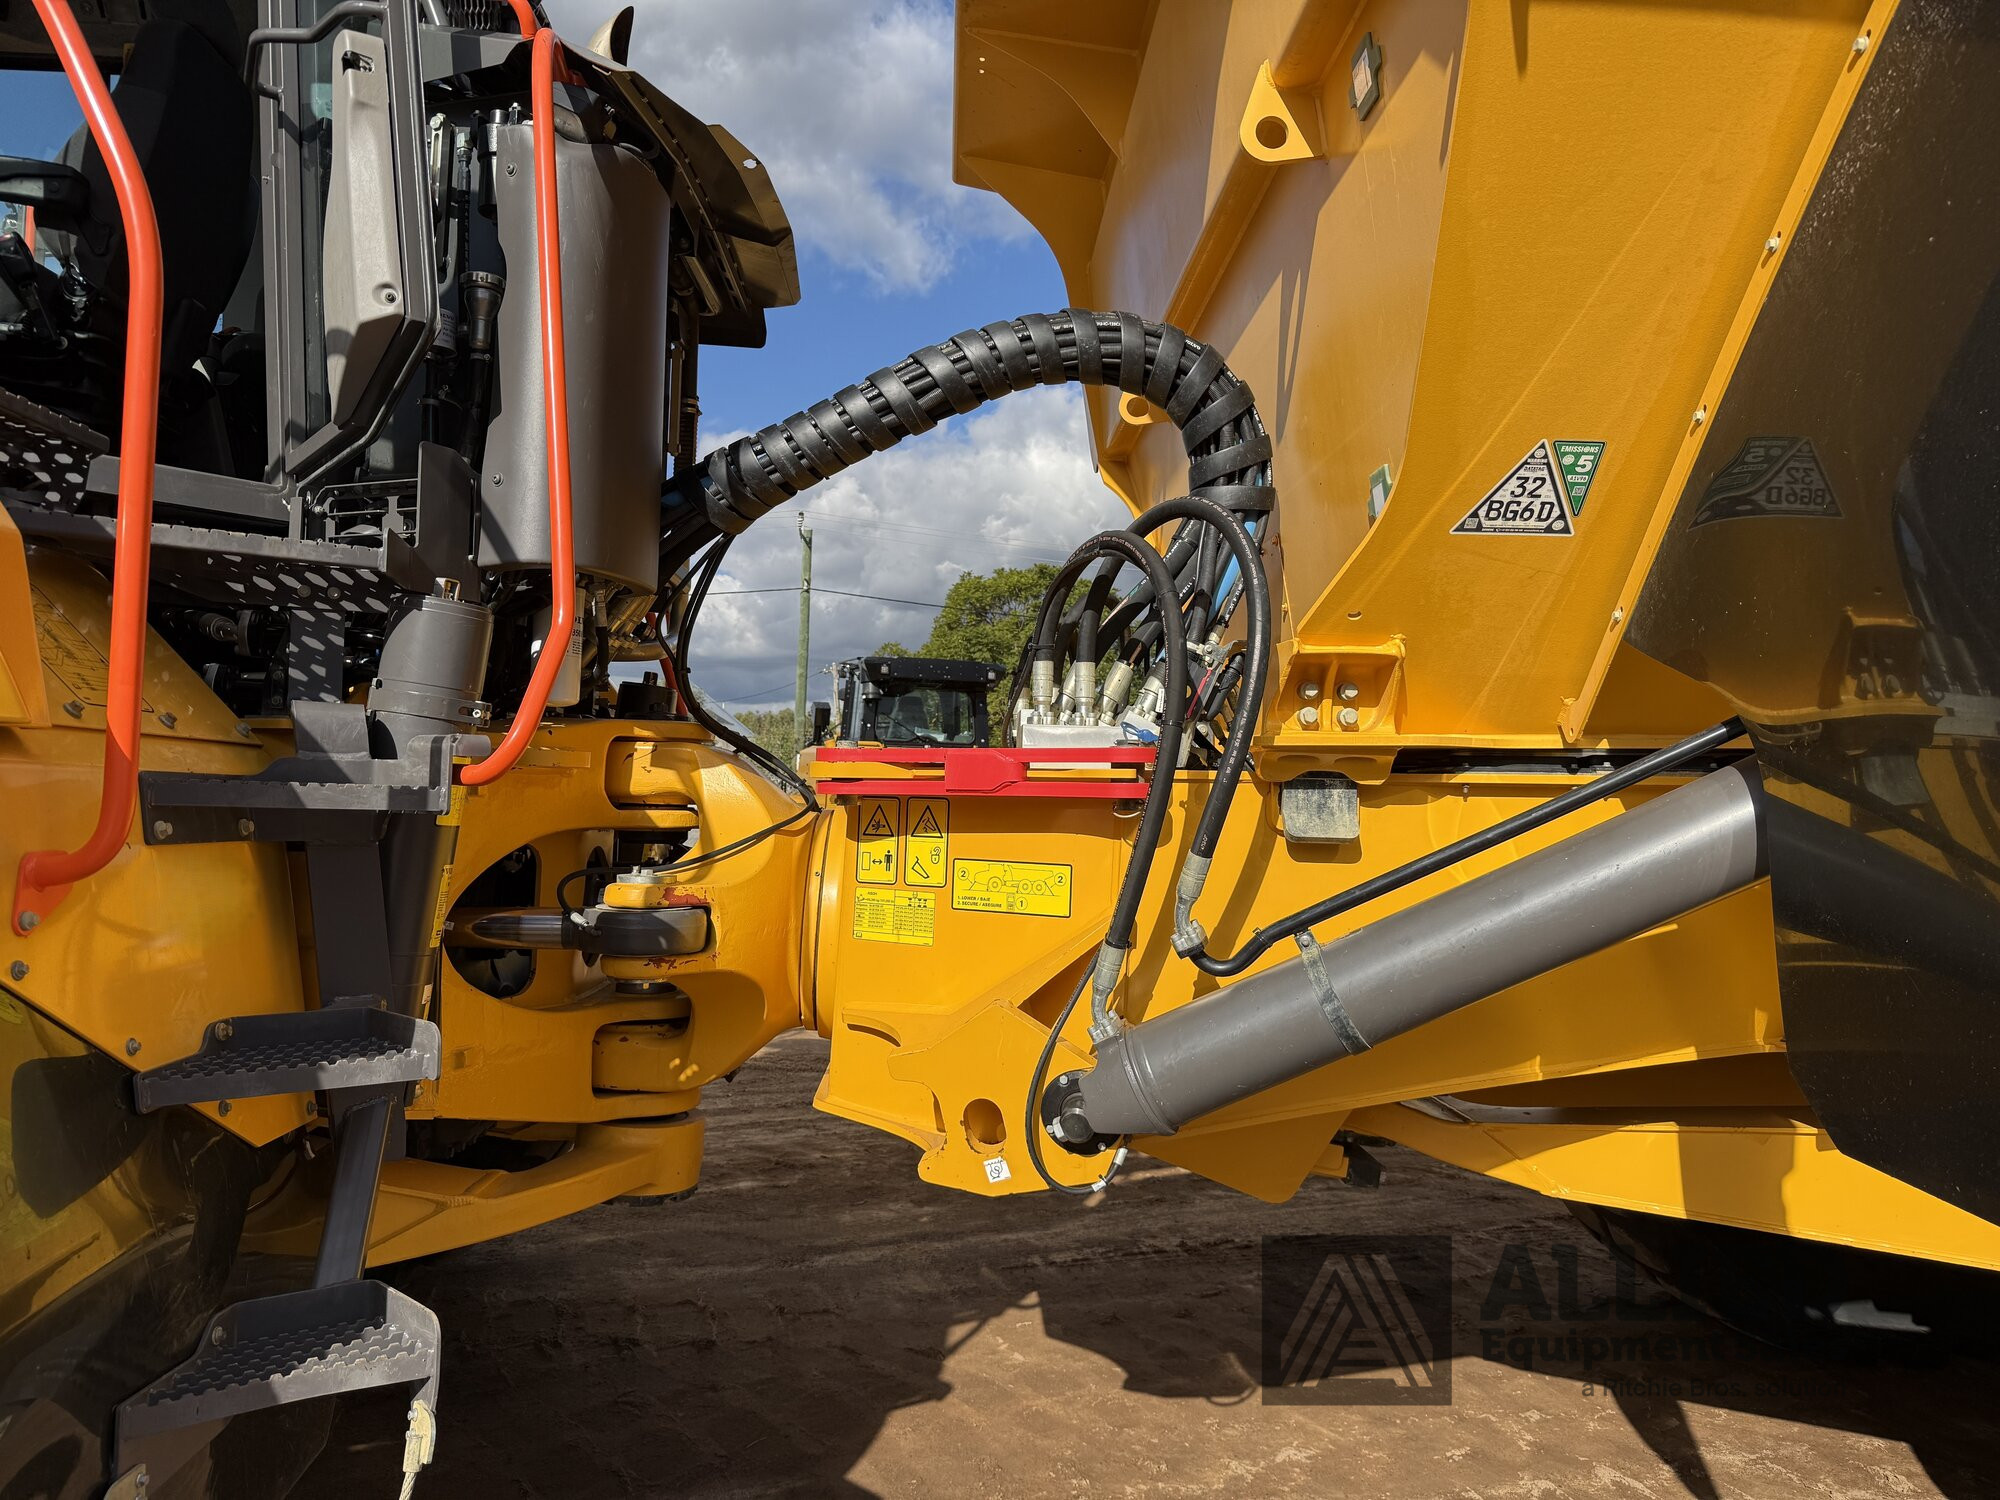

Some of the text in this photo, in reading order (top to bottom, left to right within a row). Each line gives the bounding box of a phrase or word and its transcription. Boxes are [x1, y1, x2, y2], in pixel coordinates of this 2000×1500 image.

[1575, 455, 1595, 473] 5
[1510, 476, 1547, 499] 32
[1484, 500, 1556, 522] BG6D
